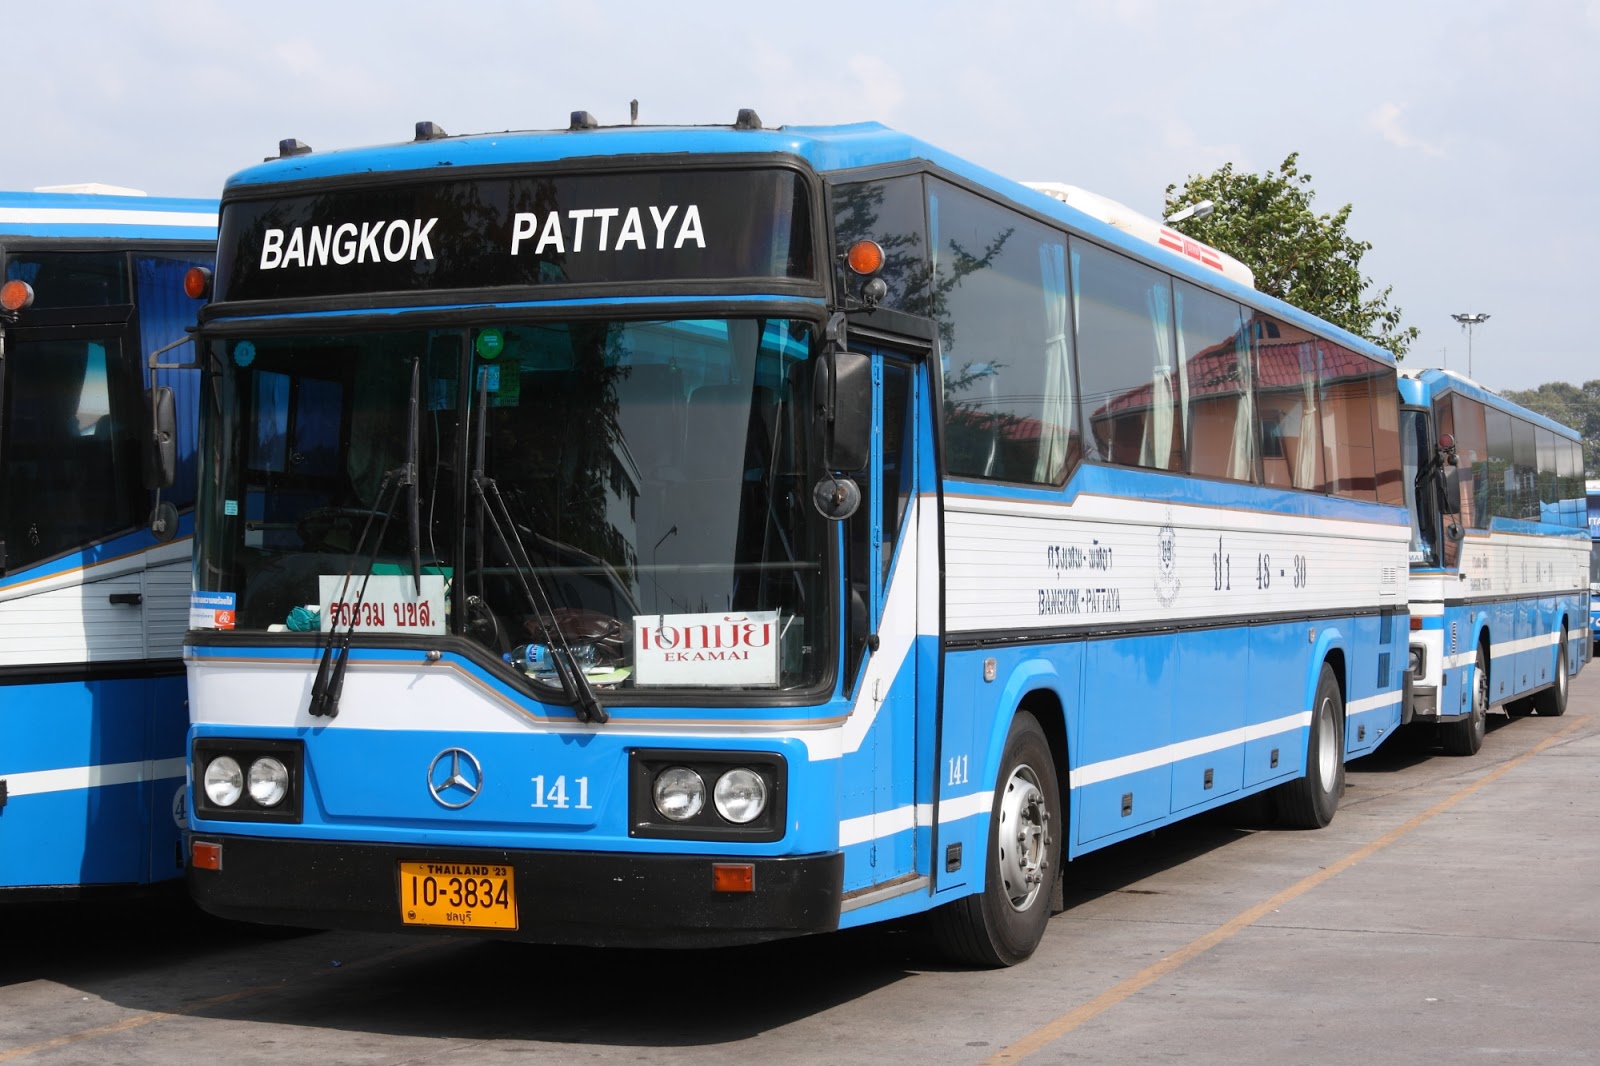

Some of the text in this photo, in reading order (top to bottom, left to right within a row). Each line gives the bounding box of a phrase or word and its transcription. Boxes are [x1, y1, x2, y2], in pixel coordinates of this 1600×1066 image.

[260, 204, 706, 270] BANGKOK PATTAYA
[1256, 552, 1270, 590] 48
[1294, 554, 1306, 589] 30
[394, 600, 435, 627] บขส.
[640, 616, 771, 650] เอกมัย
[664, 651, 749, 662] EKAMAI
[948, 754, 969, 786] 141
[531, 775, 593, 809] 141
[428, 865, 489, 876] THAILAND
[412, 876, 509, 910] 10-3834
